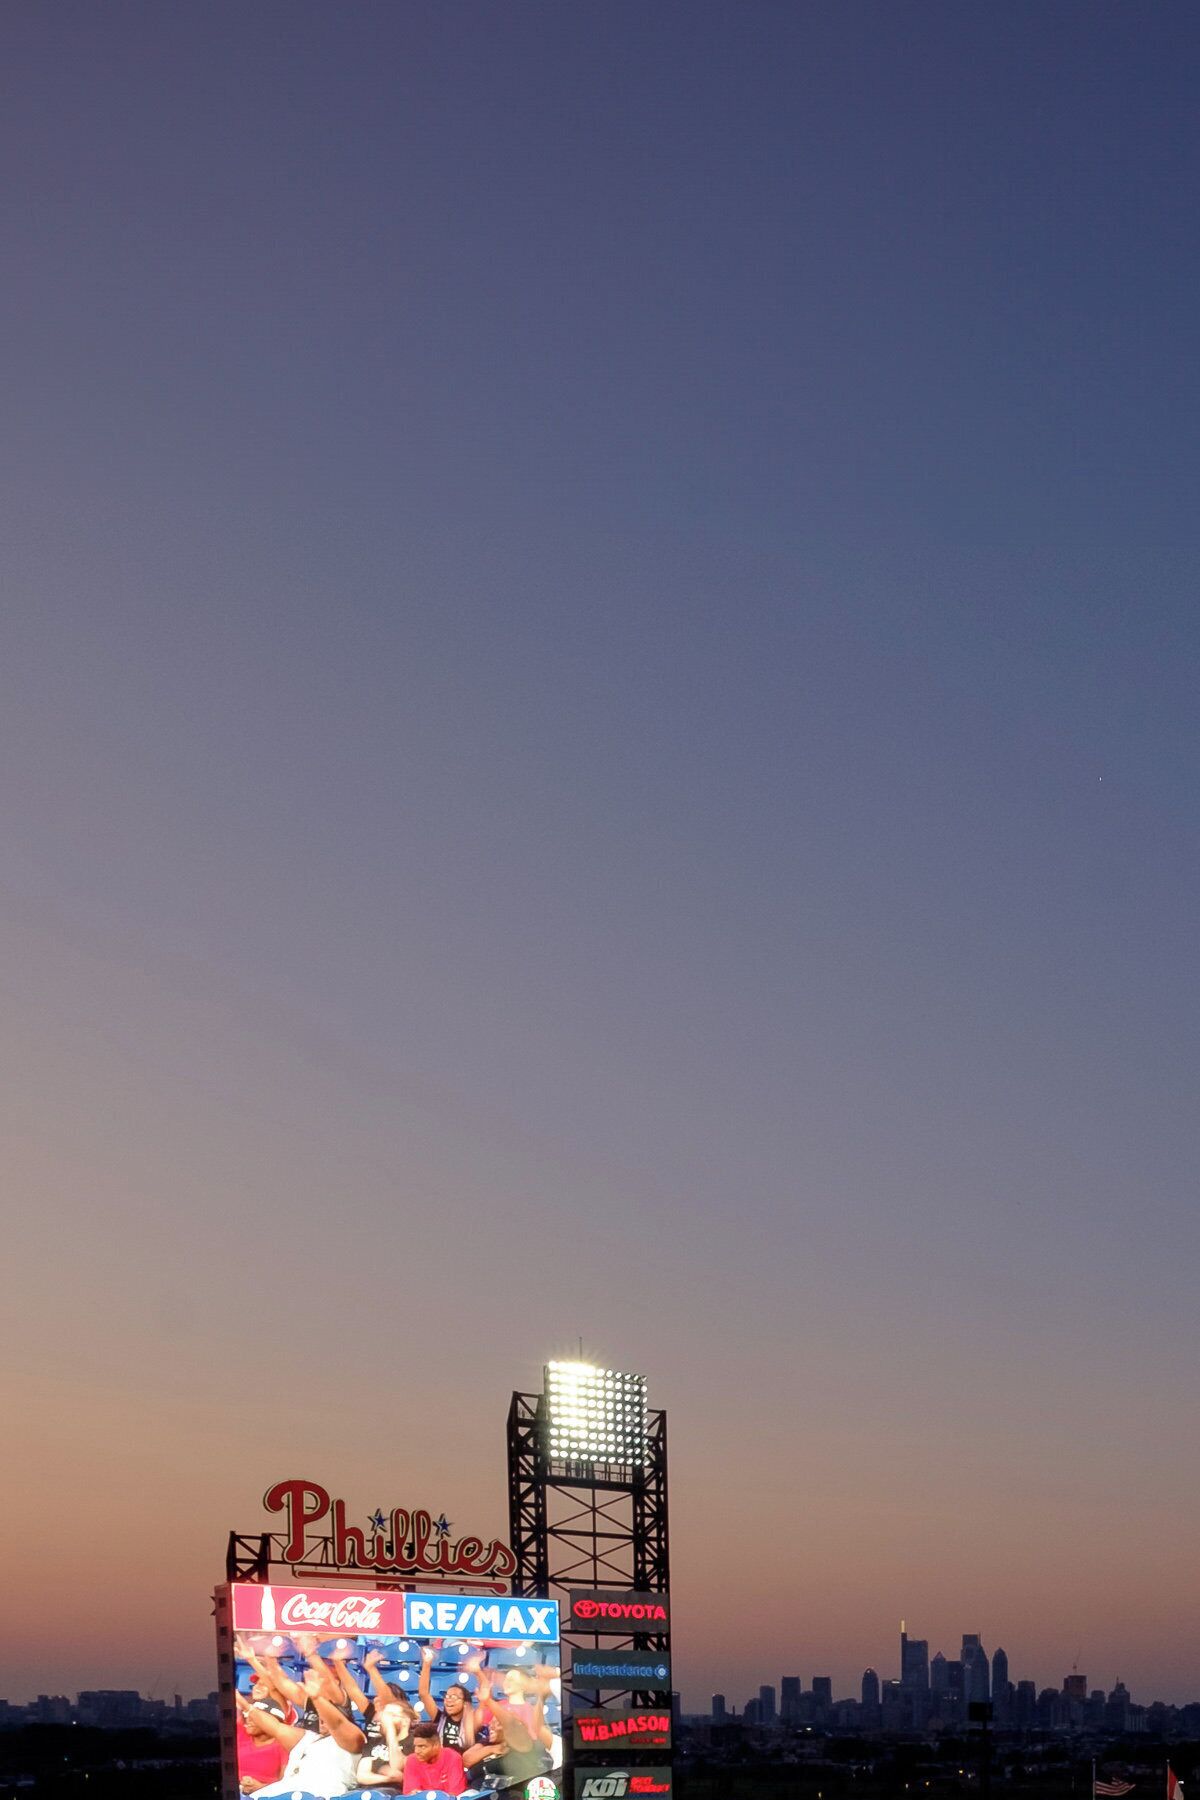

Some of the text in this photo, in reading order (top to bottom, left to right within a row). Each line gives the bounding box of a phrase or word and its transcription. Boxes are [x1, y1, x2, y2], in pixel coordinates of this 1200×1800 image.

[264, 1479, 517, 1578] Phillies
[281, 1593, 385, 1629] Coca-Cola
[410, 1601, 552, 1635] RE/MAX
[599, 1602, 667, 1620] TOYOTA
[573, 1662, 653, 1678] Independence
[582, 1778, 628, 1797] KDI
